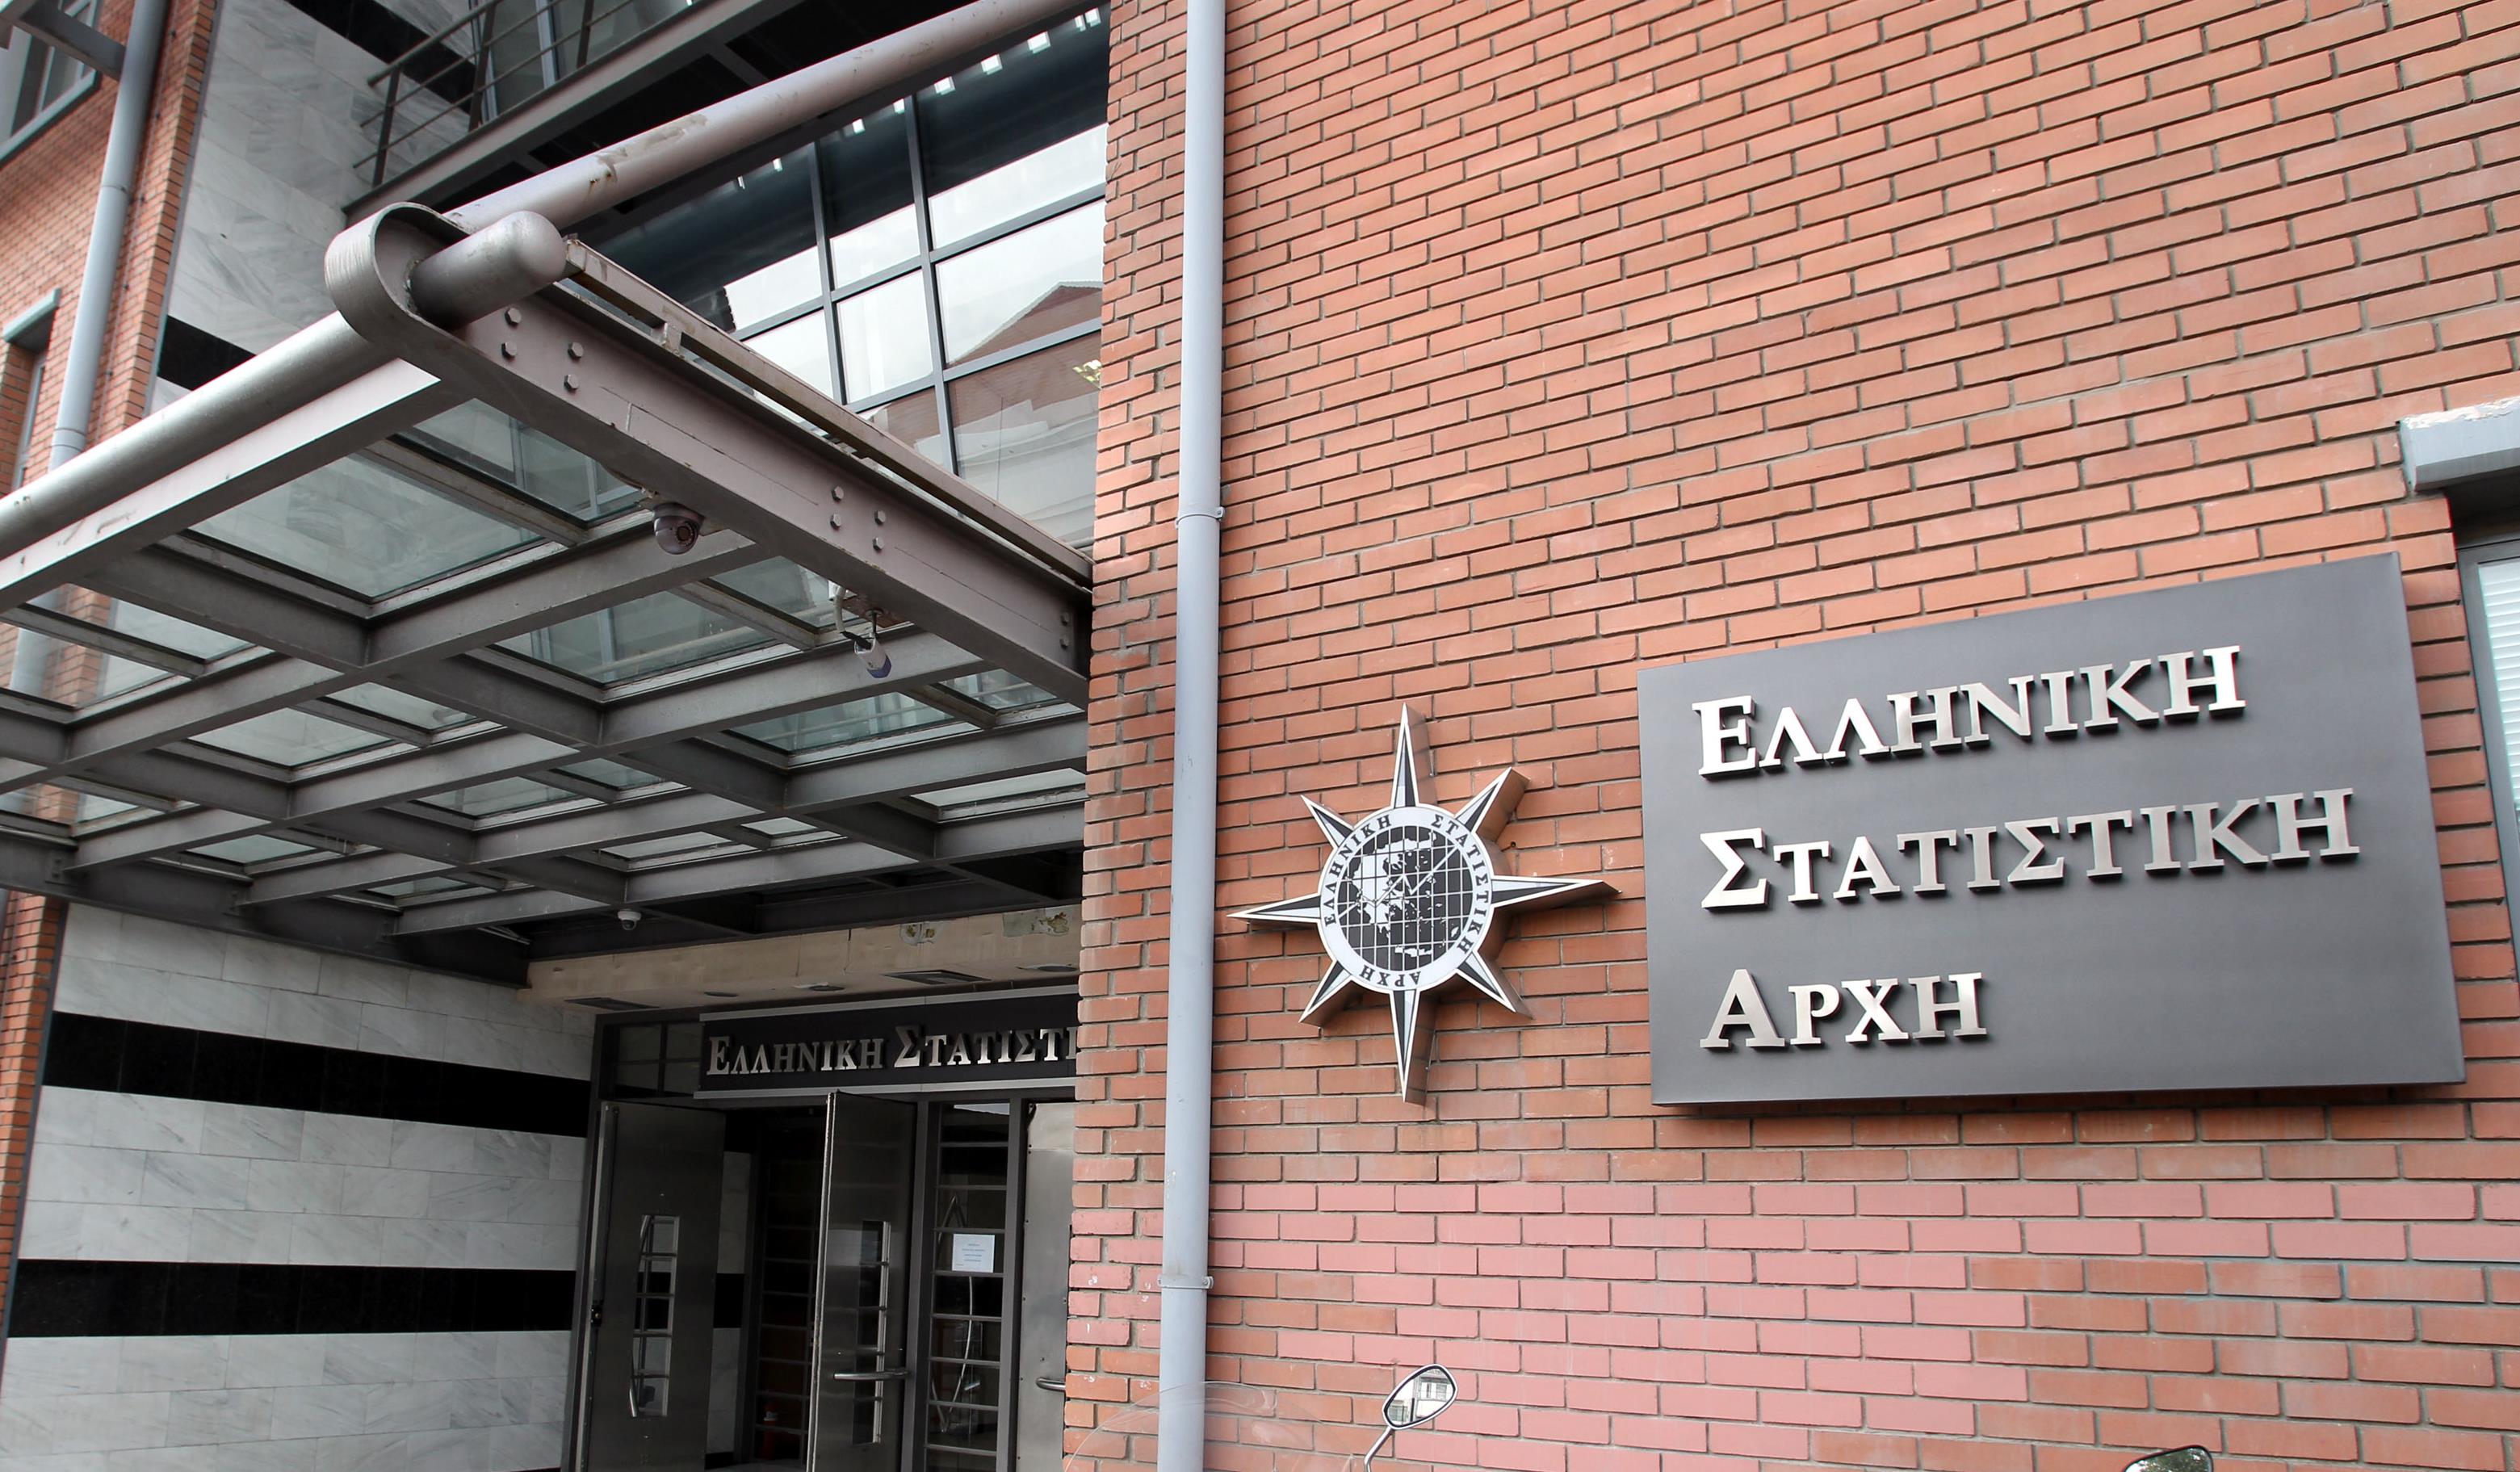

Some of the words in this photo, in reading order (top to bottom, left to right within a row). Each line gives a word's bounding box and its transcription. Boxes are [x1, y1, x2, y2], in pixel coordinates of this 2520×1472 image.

[1691, 644, 2246, 778] ΕΛΛΗΝΙΚΗ
[1323, 814, 1391, 926] ΕΛΛΗΝΙΚΗ
[1431, 814, 1490, 954] ΣΤΑΤΙΣΤΙΚΗ
[1700, 787, 2360, 911] ΣΤΑΤΙΣΤΙΚΗ
[1359, 964, 1422, 987] ΑΡΧΗ
[1700, 968, 1988, 1050] ΑΡΧΗ
[707, 1036, 884, 1075] ΕΛΛΗΝΙΚΗ
